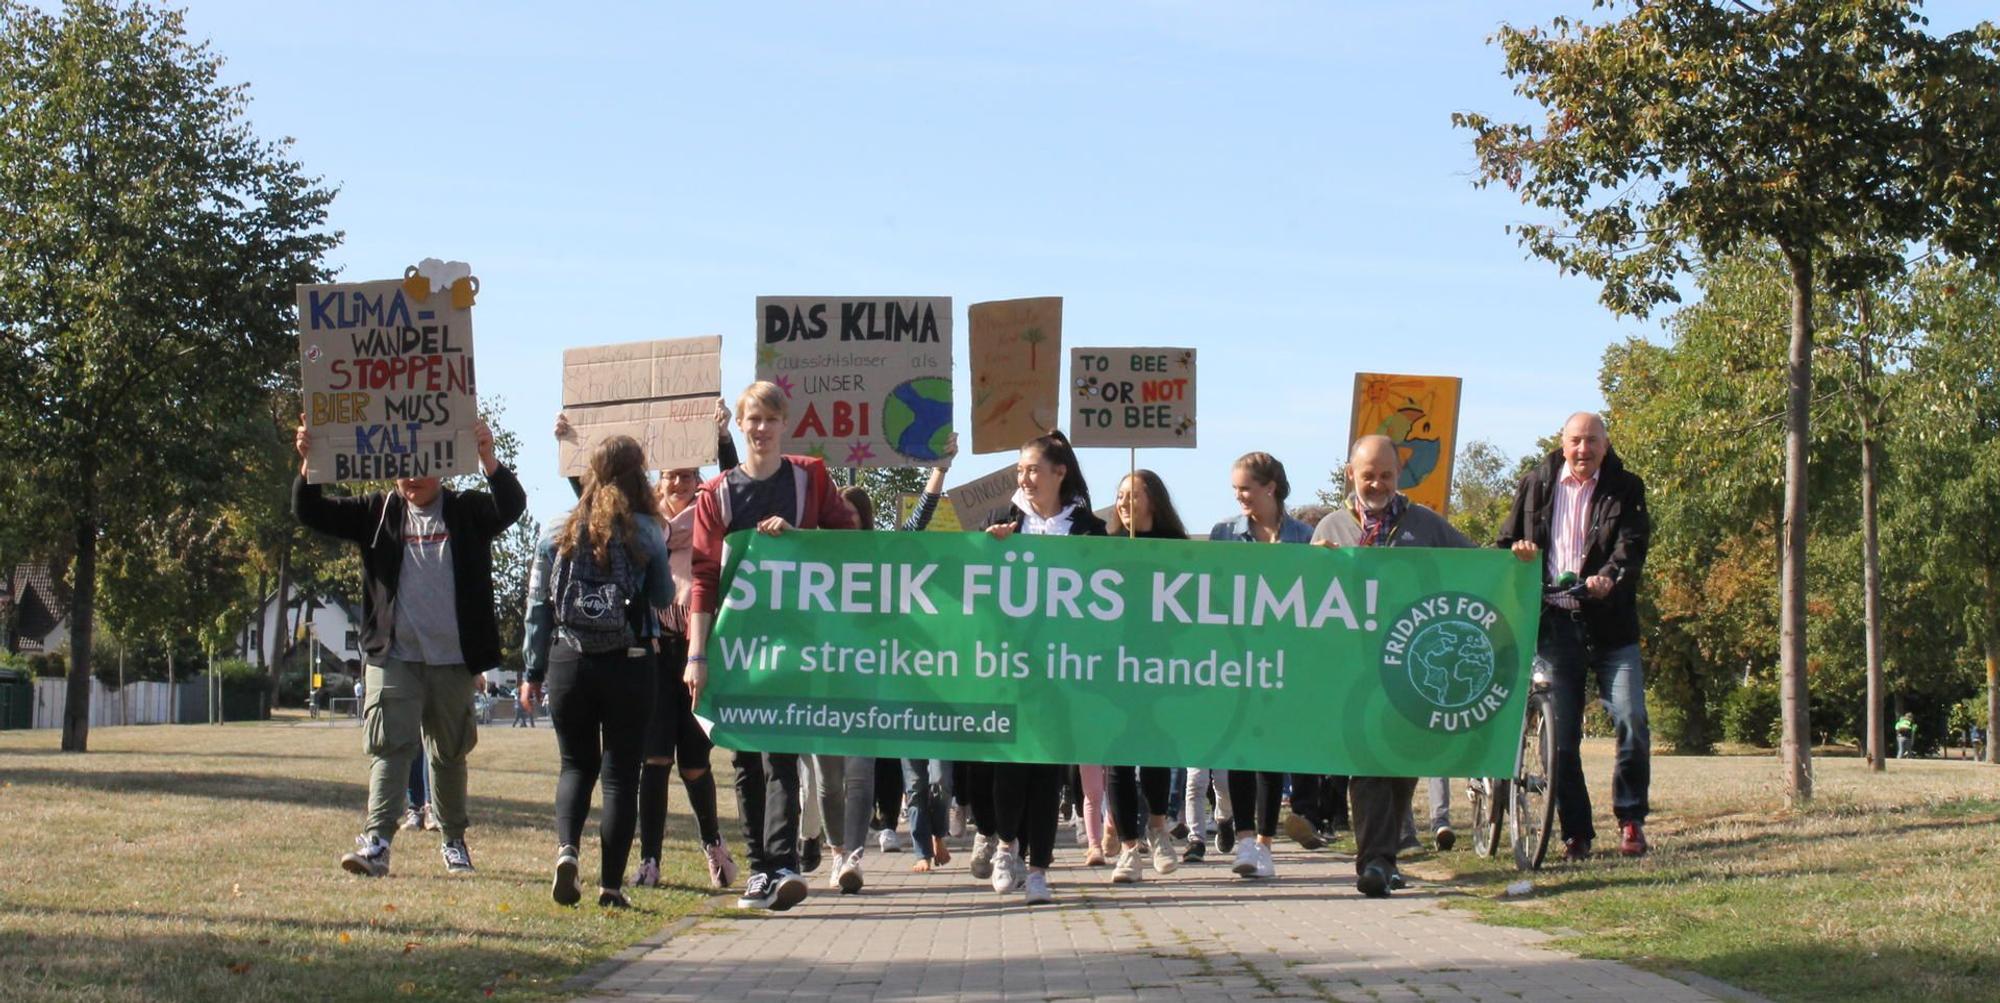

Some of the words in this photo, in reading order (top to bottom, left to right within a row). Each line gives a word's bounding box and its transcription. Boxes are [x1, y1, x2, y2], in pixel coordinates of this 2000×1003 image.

[765, 303, 828, 344] DAS
[840, 301, 940, 343] KLIMA
[351, 325, 463, 357] WANDEL
[329, 355, 476, 396] STOPPEN!
[911, 355, 938, 368] als
[1080, 355, 1109, 372] TO
[1130, 355, 1168, 372] BEE
[803, 374, 865, 395] UNSER
[1101, 381, 1135, 404] OR
[1141, 378, 1188, 403] NOT
[312, 392, 372, 426] BIER
[385, 392, 450, 426] MUSS
[791, 400, 870, 438] ABI
[1078, 408, 1112, 428] TO
[1124, 405, 1171, 428] BEE
[355, 423, 423, 455] KALT
[726, 559, 939, 615] STREIK
[962, 550, 1125, 622] FÜRS
[1151, 571, 1379, 632] KLIMA!
[1384, 597, 1450, 665] FRIDAYS
[1456, 597, 1498, 630] FOR
[720, 635, 786, 672] Wir
[799, 638, 959, 677] streiken
[975, 640, 1030, 679] bis
[1047, 642, 1102, 681] ihr
[1117, 645, 1284, 690] handelt!
[719, 703, 1011, 735] www.fridaysforfuture.de
[1429, 683, 1509, 731] FUTURE
